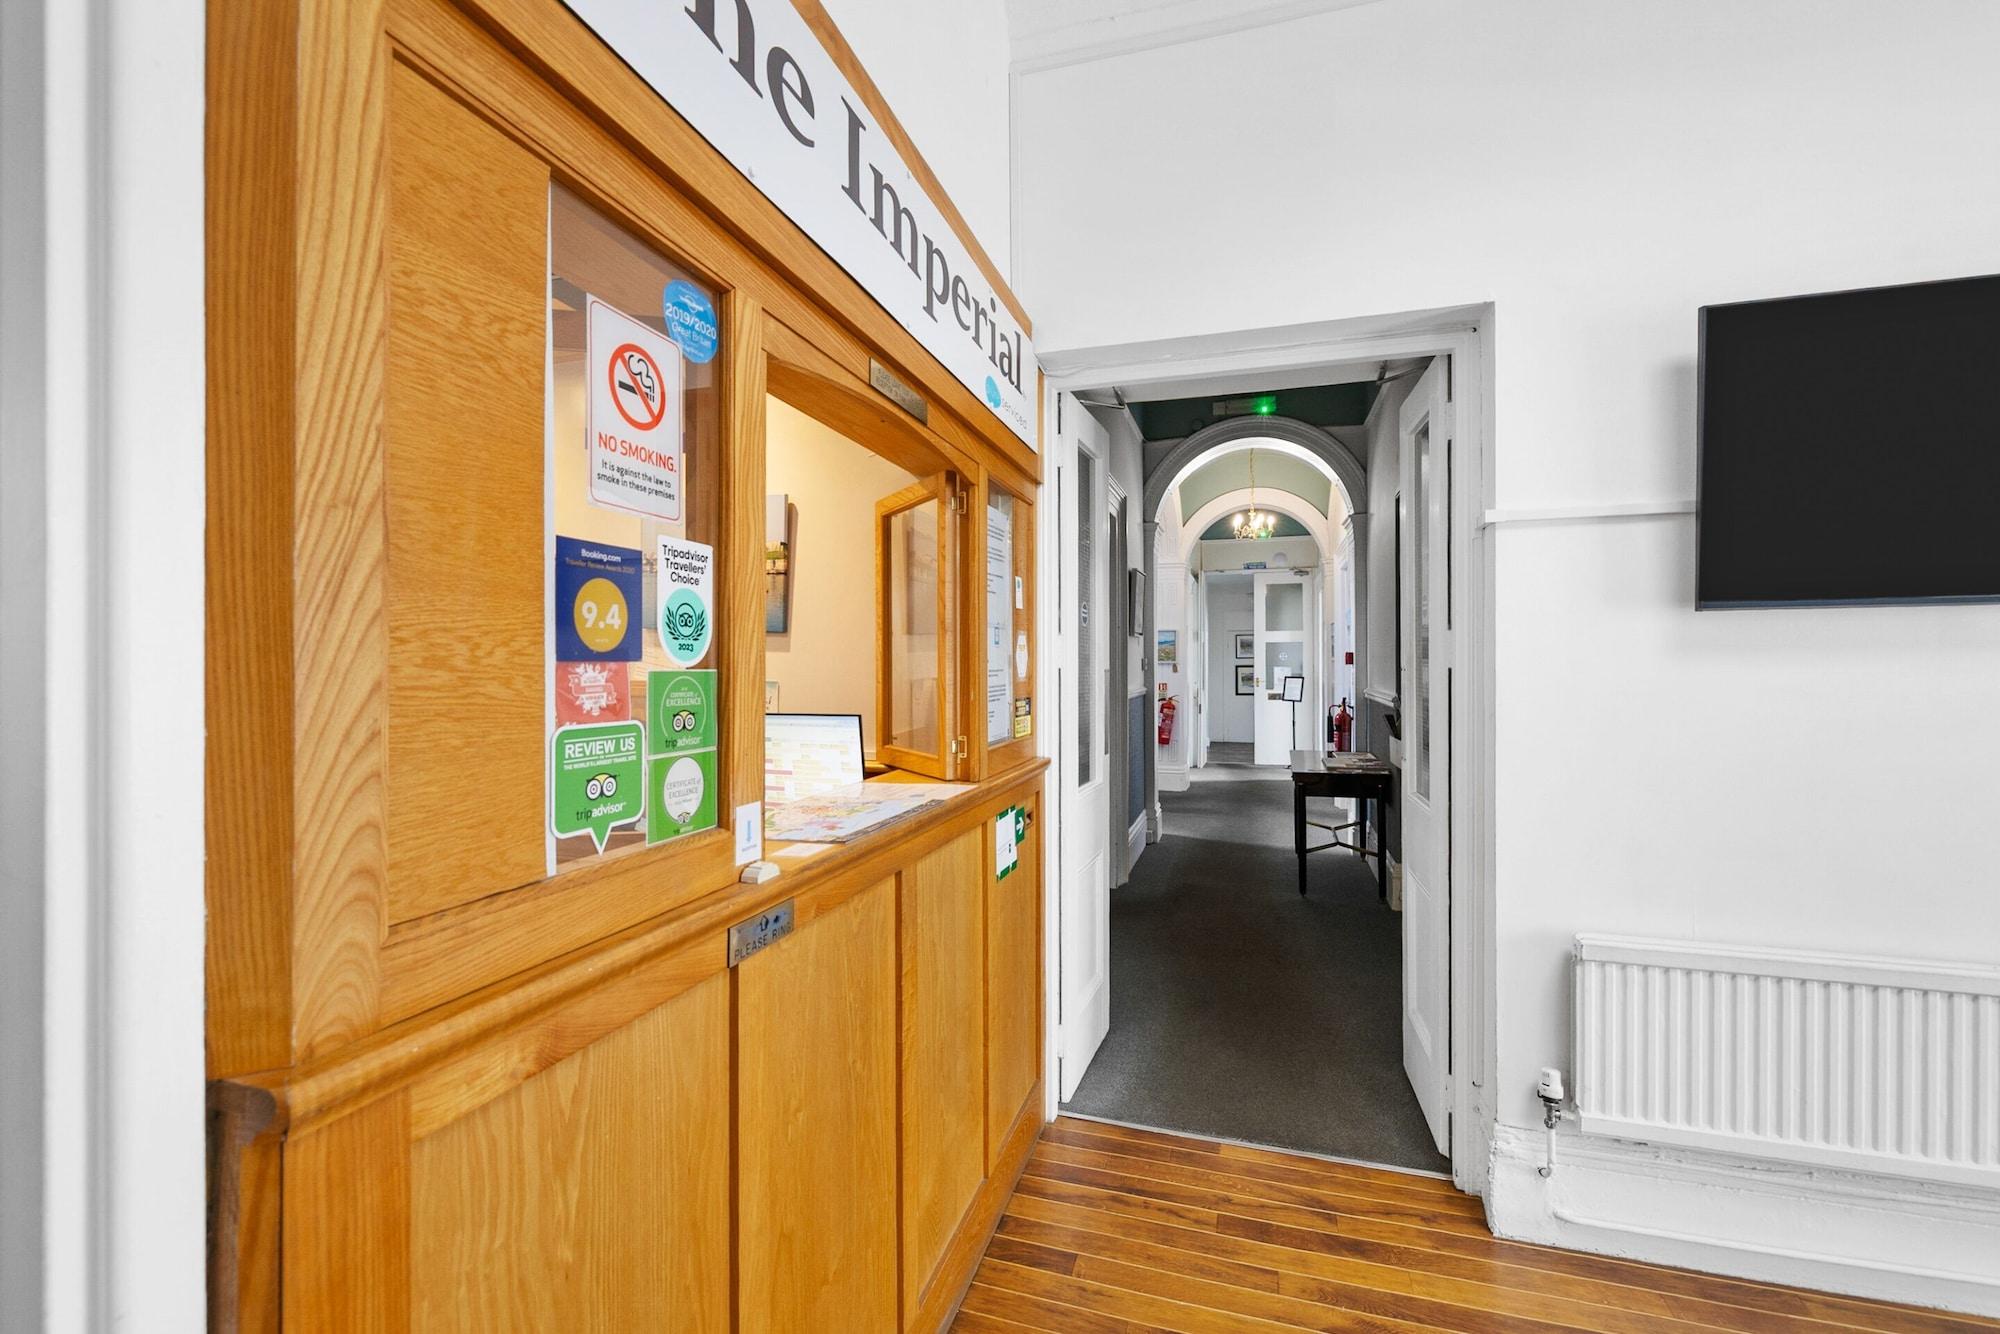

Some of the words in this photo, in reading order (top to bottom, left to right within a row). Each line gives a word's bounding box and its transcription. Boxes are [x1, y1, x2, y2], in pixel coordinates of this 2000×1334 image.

[841, 95, 1022, 395] Imperial
[665, 302, 717, 340] 2019/2020
[598, 432, 617, 452] NO
[620, 440, 677, 473] SMOKING.
[602, 459, 608, 470] It
[609, 463, 615, 471] is
[616, 465, 640, 478] against
[641, 471, 652, 482] the
[653, 475, 664, 486] law
[665, 480, 672, 488] to
[597, 472, 620, 485] smoke
[621, 478, 628, 487] in
[629, 480, 647, 493] these
[648, 486, 676, 501] premises
[581, 548, 621, 562] Booking.com
[662, 544, 709, 564] Tripadvisor
[664, 558, 707, 575] Travellers'
[670, 572, 700, 586] Choice
[581, 600, 622, 630] 9.4
[678, 643, 694, 652] 2023
[565, 740, 616, 759] REVIEW
[620, 737, 636, 752] US
[576, 803, 624, 822] tripadvisor
[734, 934, 768, 960] PLEASE
[772, 922, 793, 940] RING
